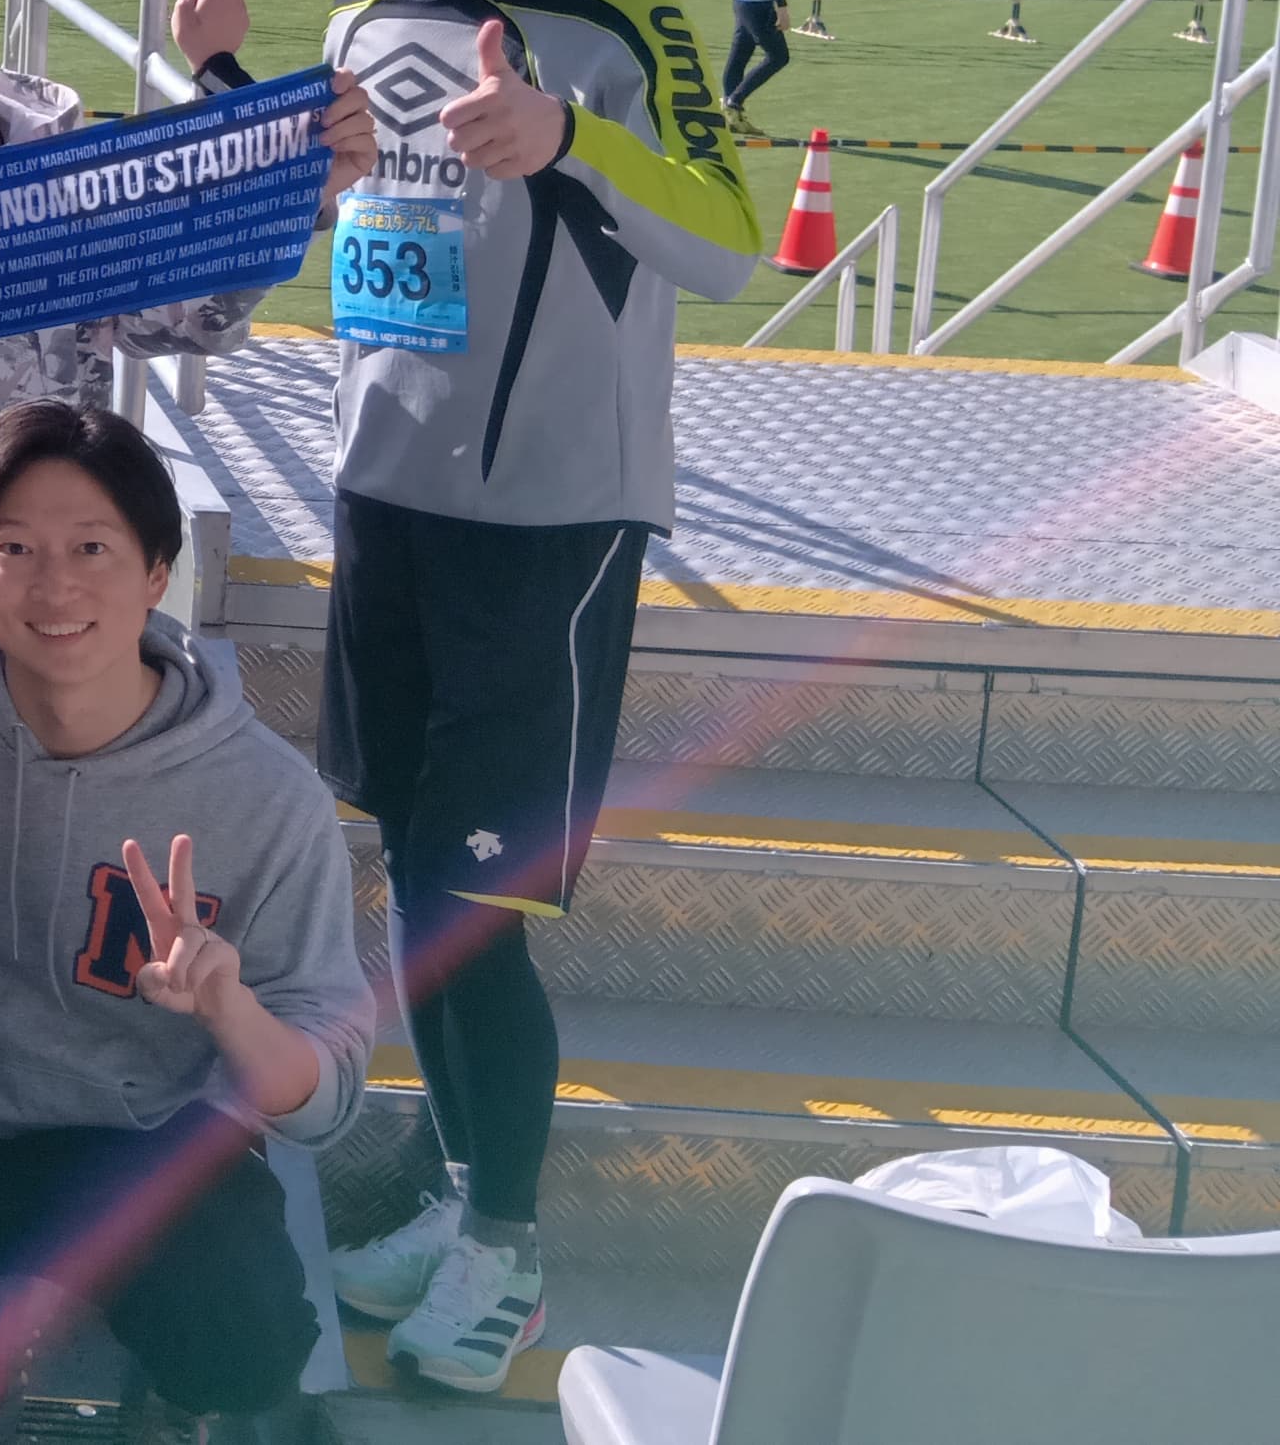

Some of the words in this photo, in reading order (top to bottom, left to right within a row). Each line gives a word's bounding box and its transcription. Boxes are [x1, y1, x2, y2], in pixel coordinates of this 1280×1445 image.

[6, 158, 39, 178] RELAY
[40, 145, 98, 167] MARATHON
[100, 140, 114, 155] AT
[115, 125, 175, 151] AJINOMOTO
[175, 111, 224, 136] STADIUM
[233, 102, 256, 120] THE
[280, 81, 328, 106] CHARITY
[153, 110, 312, 195] STADIUM
[378, 142, 466, 188] mbro
[7, 250, 65, 272] MARATHON
[65, 245, 80, 260] AT
[80, 232, 137, 258] AJINOMOTO
[139, 221, 184, 244] STADIUM
[193, 214, 214, 231] THE
[214, 206, 235, 225] 5TH
[236, 197, 281, 221] CHARITY
[282, 189, 318, 208] RELAY
[12, 223, 69, 246] MARATHON
[71, 219, 85, 234] AT
[85, 206, 143, 231] AJINOMOTO
[144, 194, 190, 218] STADIUM
[199, 187, 221, 204] THE
[243, 169, 288, 193] CHARITY
[289, 159, 324, 180] RELAY
[342, 235, 431, 301] 353
